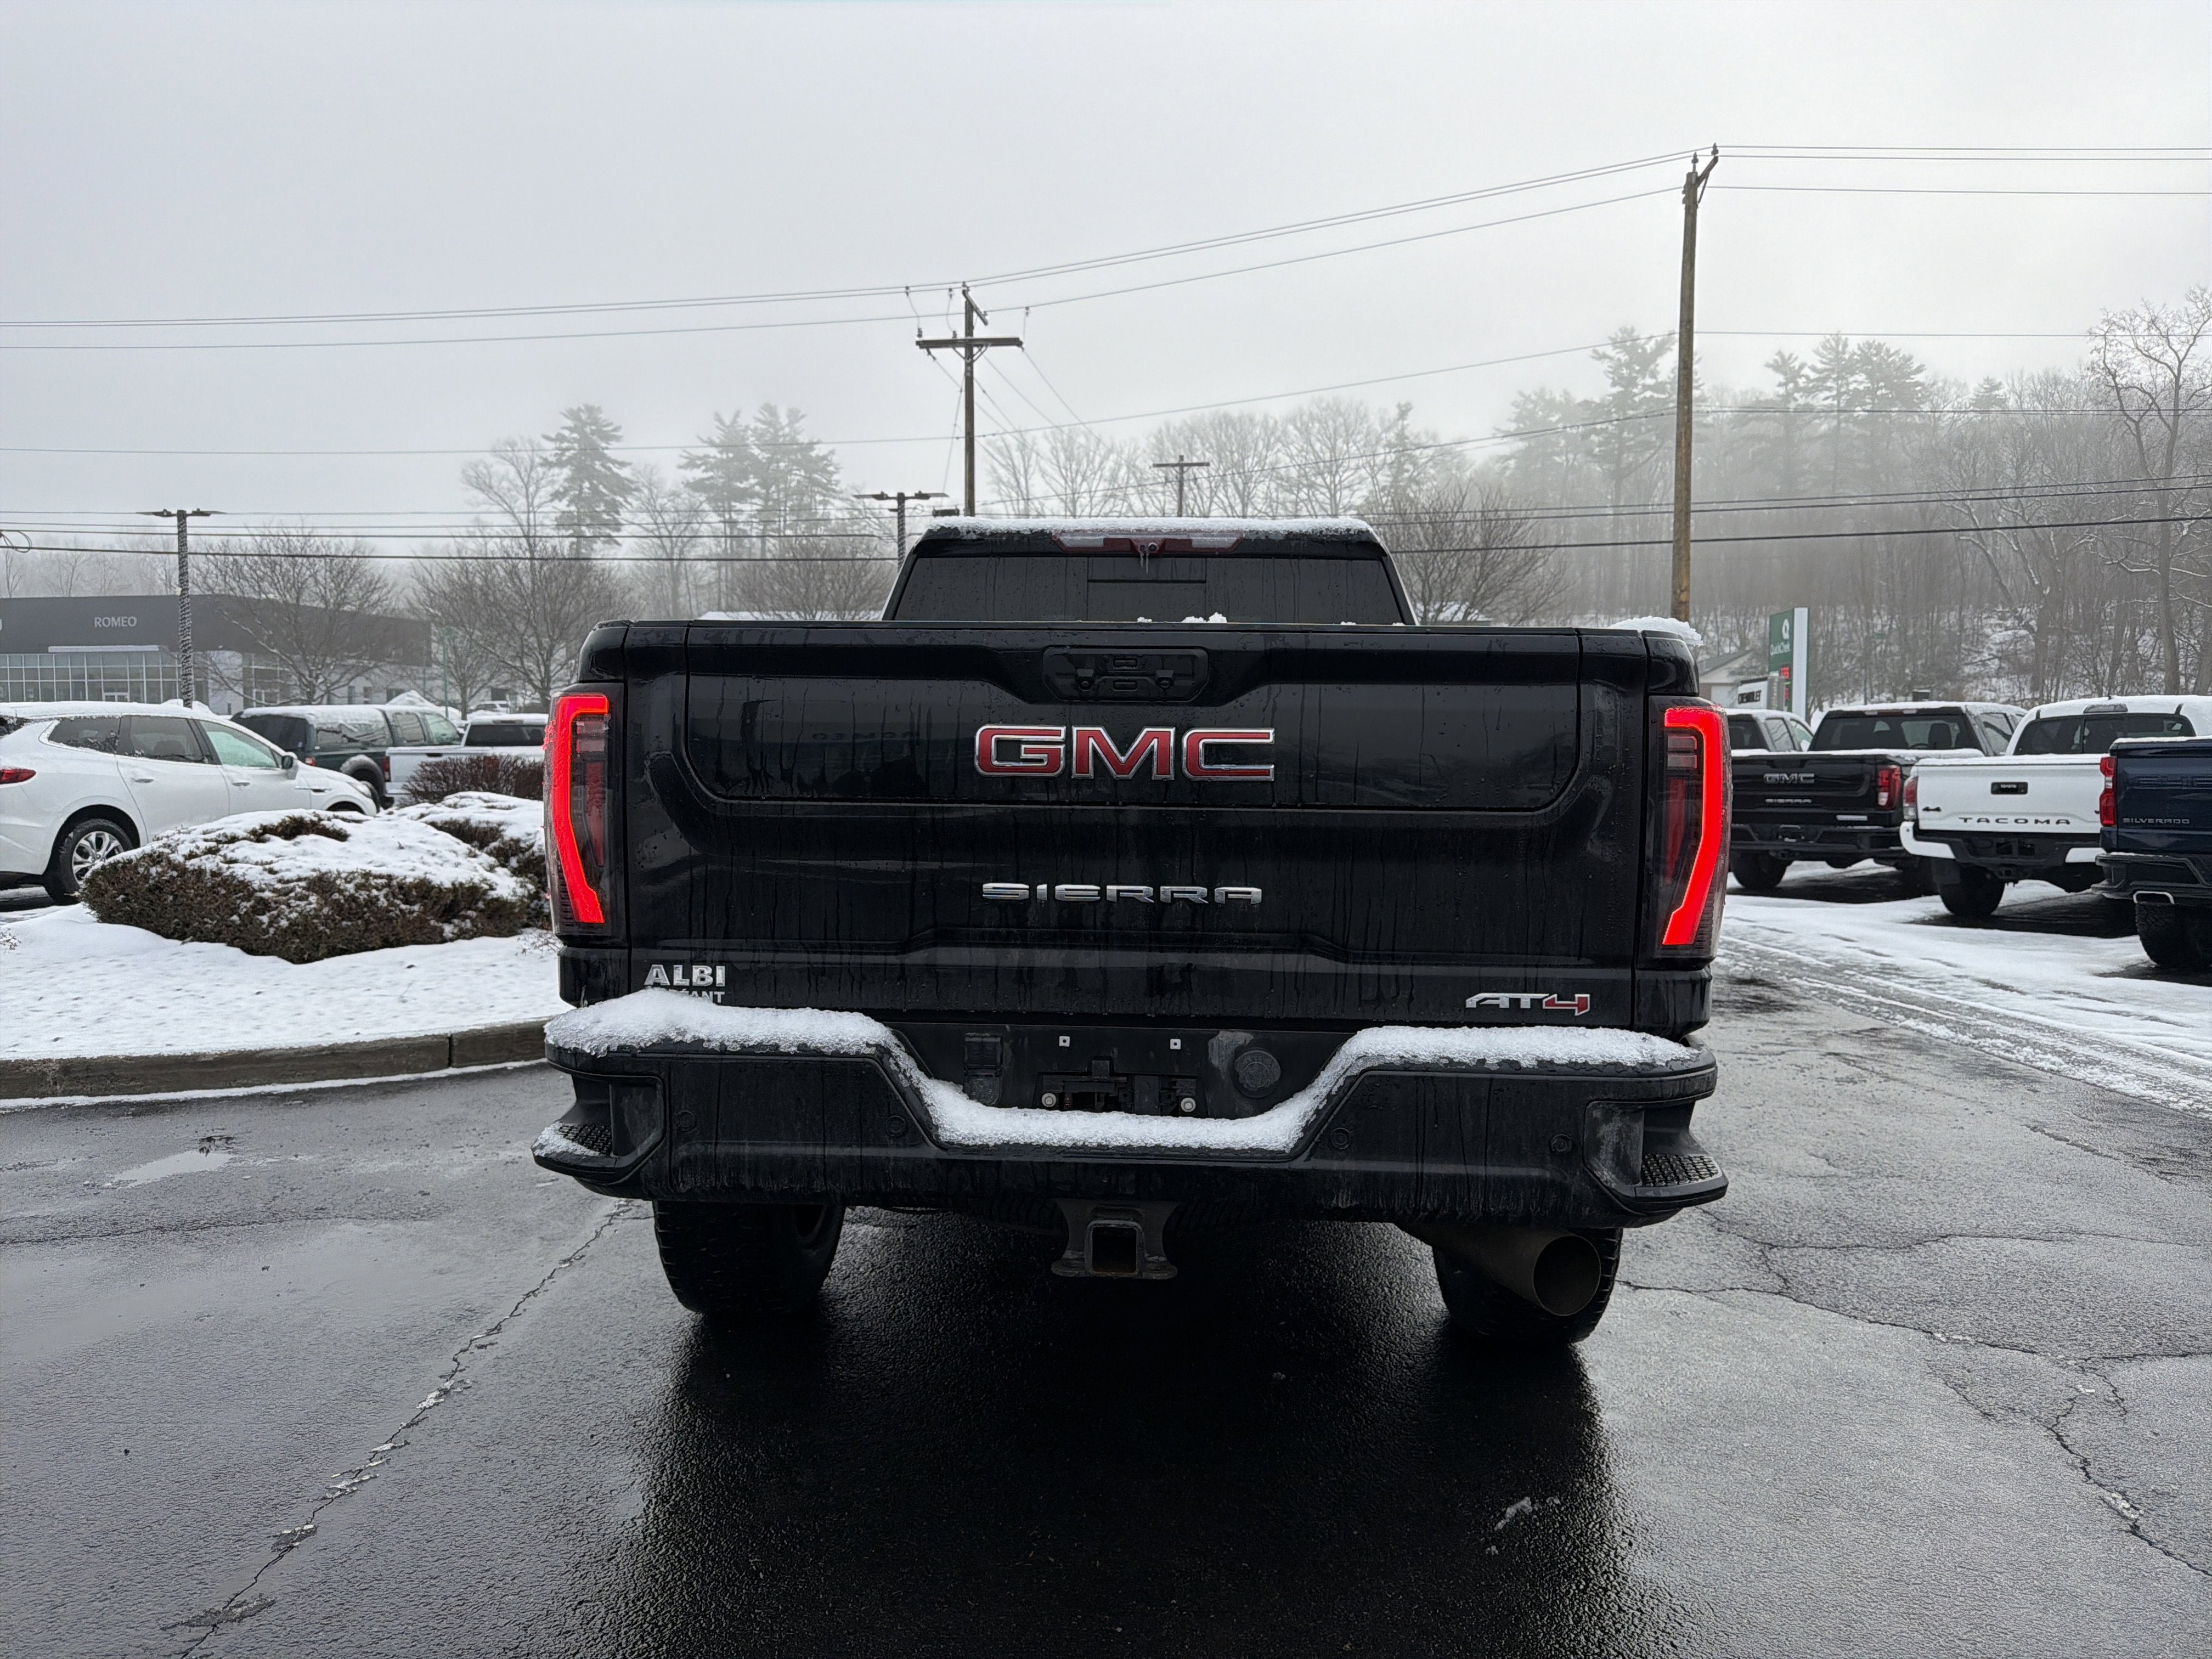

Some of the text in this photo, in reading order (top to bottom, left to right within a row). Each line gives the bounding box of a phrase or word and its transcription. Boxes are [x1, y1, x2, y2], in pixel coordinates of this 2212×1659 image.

[94, 617, 137, 628] ROMEO
[974, 725, 1275, 781] GMC
[1763, 773, 1815, 783] GMC
[982, 883, 1263, 904] SIERRA
[644, 964, 725, 986] ALBI
[1465, 992, 1590, 1015] AT4
